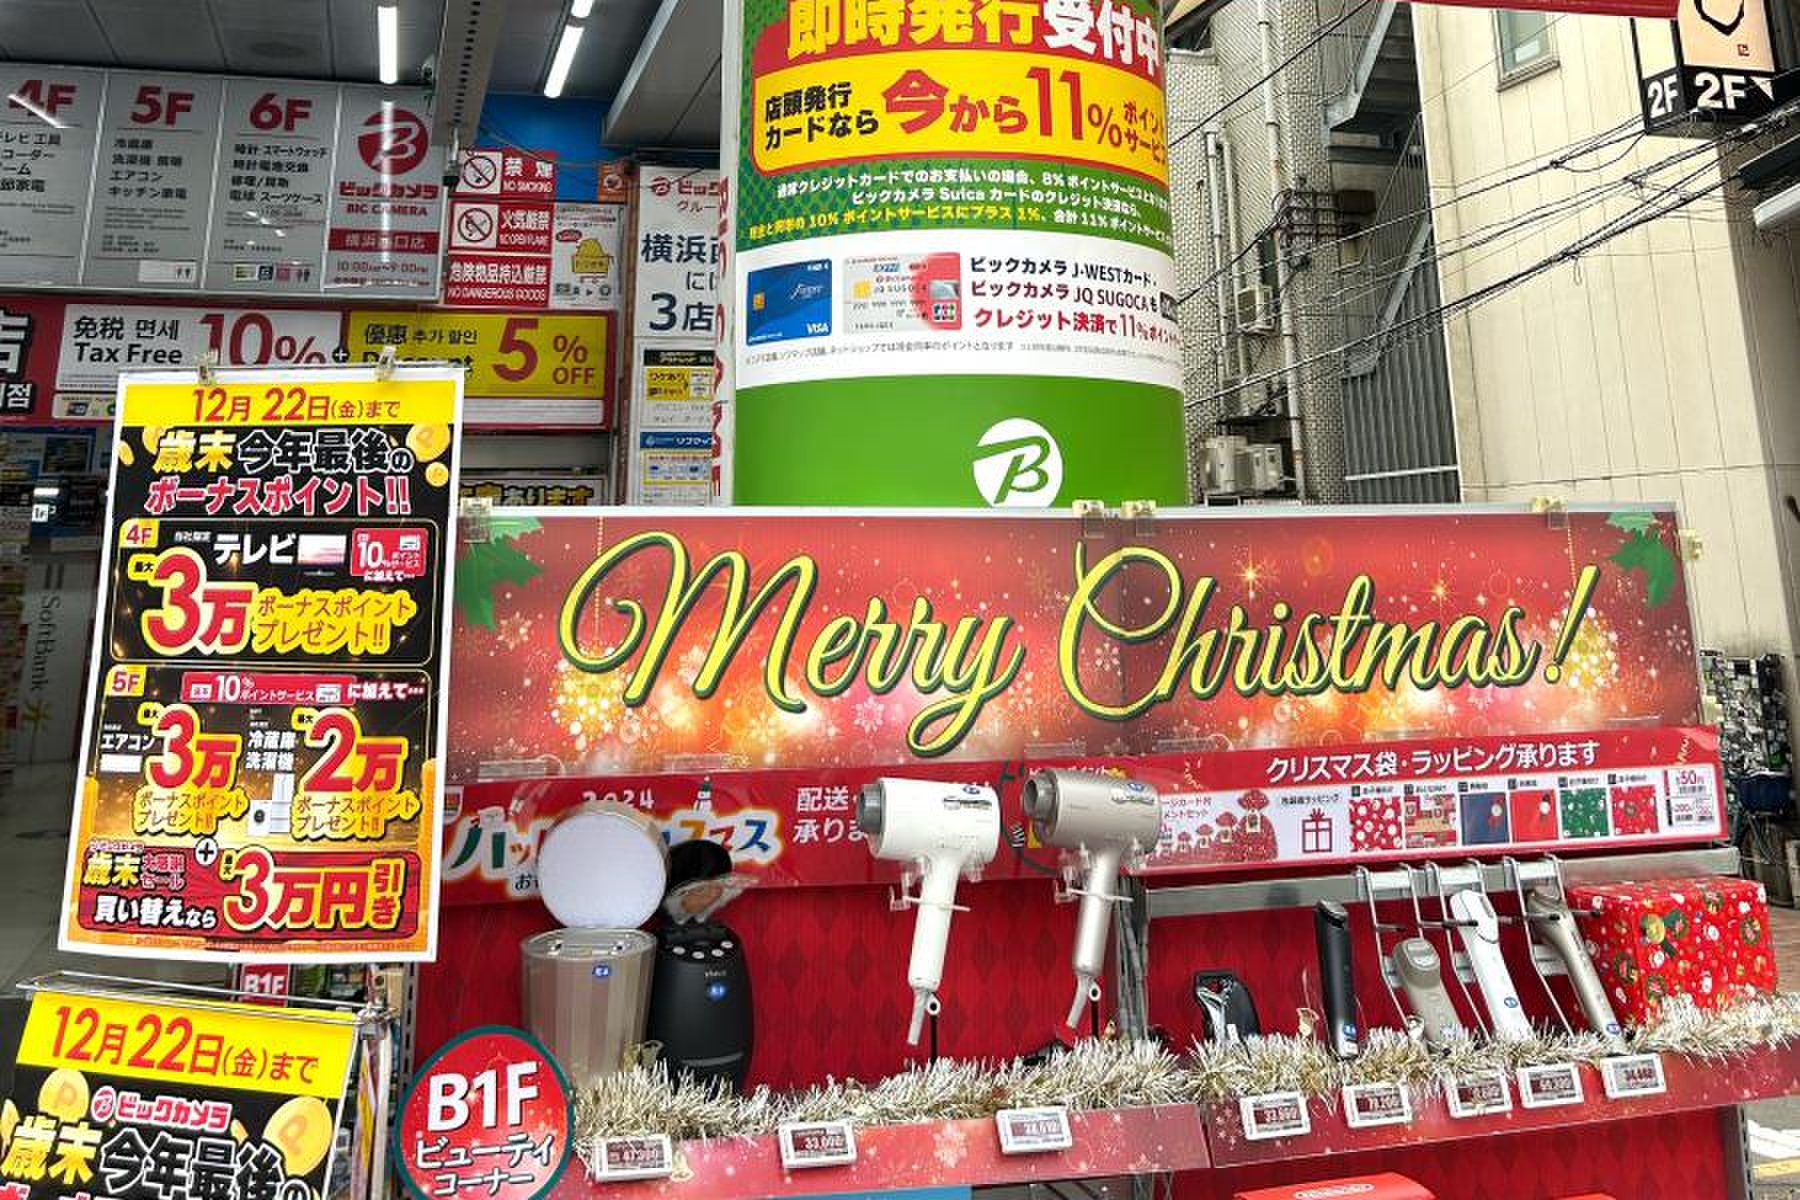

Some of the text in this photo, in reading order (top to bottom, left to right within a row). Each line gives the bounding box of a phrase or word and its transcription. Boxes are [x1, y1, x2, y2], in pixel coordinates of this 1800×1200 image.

[8, 79, 76, 116] 4F
[131, 86, 195, 126] 5F
[765, 82, 851, 123] 店頭発行
[1649, 74, 1679, 117] 2F
[1695, 75, 1746, 110] 2F
[249, 92, 312, 132] 6F
[765, 109, 879, 150] カードなら
[109, 170, 163, 182] エアコン
[372, 204, 427, 216] CMERA
[852, 187, 934, 205] ビックカメラ
[940, 187, 985, 201] Suica
[971, 256, 1068, 276] ビックカメラ
[971, 280, 1069, 300] ビックカメラ
[1073, 287, 1094, 307] JQ
[649, 293, 714, 331] 3店
[136, 320, 179, 341] 면세
[74, 342, 182, 365] Tax Free
[552, 366, 596, 386] OFF
[145, 475, 412, 515] ボーナスポイント!!
[125, 524, 153, 546] 4F
[214, 532, 297, 566] テレビ
[145, 554, 252, 648] 3万
[258, 595, 411, 618] ボーナスポイント
[31, 593, 60, 690] SoftBank
[256, 621, 385, 648] プレゼント!!
[562, 531, 1603, 757] Merry Christmas!
[111, 671, 140, 694] 5F
[101, 731, 156, 751] エアコン
[150, 710, 238, 790] 3万
[304, 712, 403, 793] 2万
[1267, 740, 1600, 785] クリスマス袋・ラッピング承ります
[139, 793, 244, 811] ボーナスポイント
[298, 793, 416, 811] ボーナスポイント
[83, 853, 140, 888] 歳末
[140, 872, 185, 891] セール
[226, 851, 366, 926] 3万円
[372, 861, 400, 927] 引き
[94, 894, 217, 928] 買い替えなら
[244, 970, 287, 997] B1F
[54, 1004, 320, 1086] 12月22日(金)まで
[114, 1092, 234, 1132] ビックカメラ
[427, 1061, 539, 1134] B1F
[414, 1131, 555, 1171] ビューティ
[432, 1169, 535, 1198] コーナー
